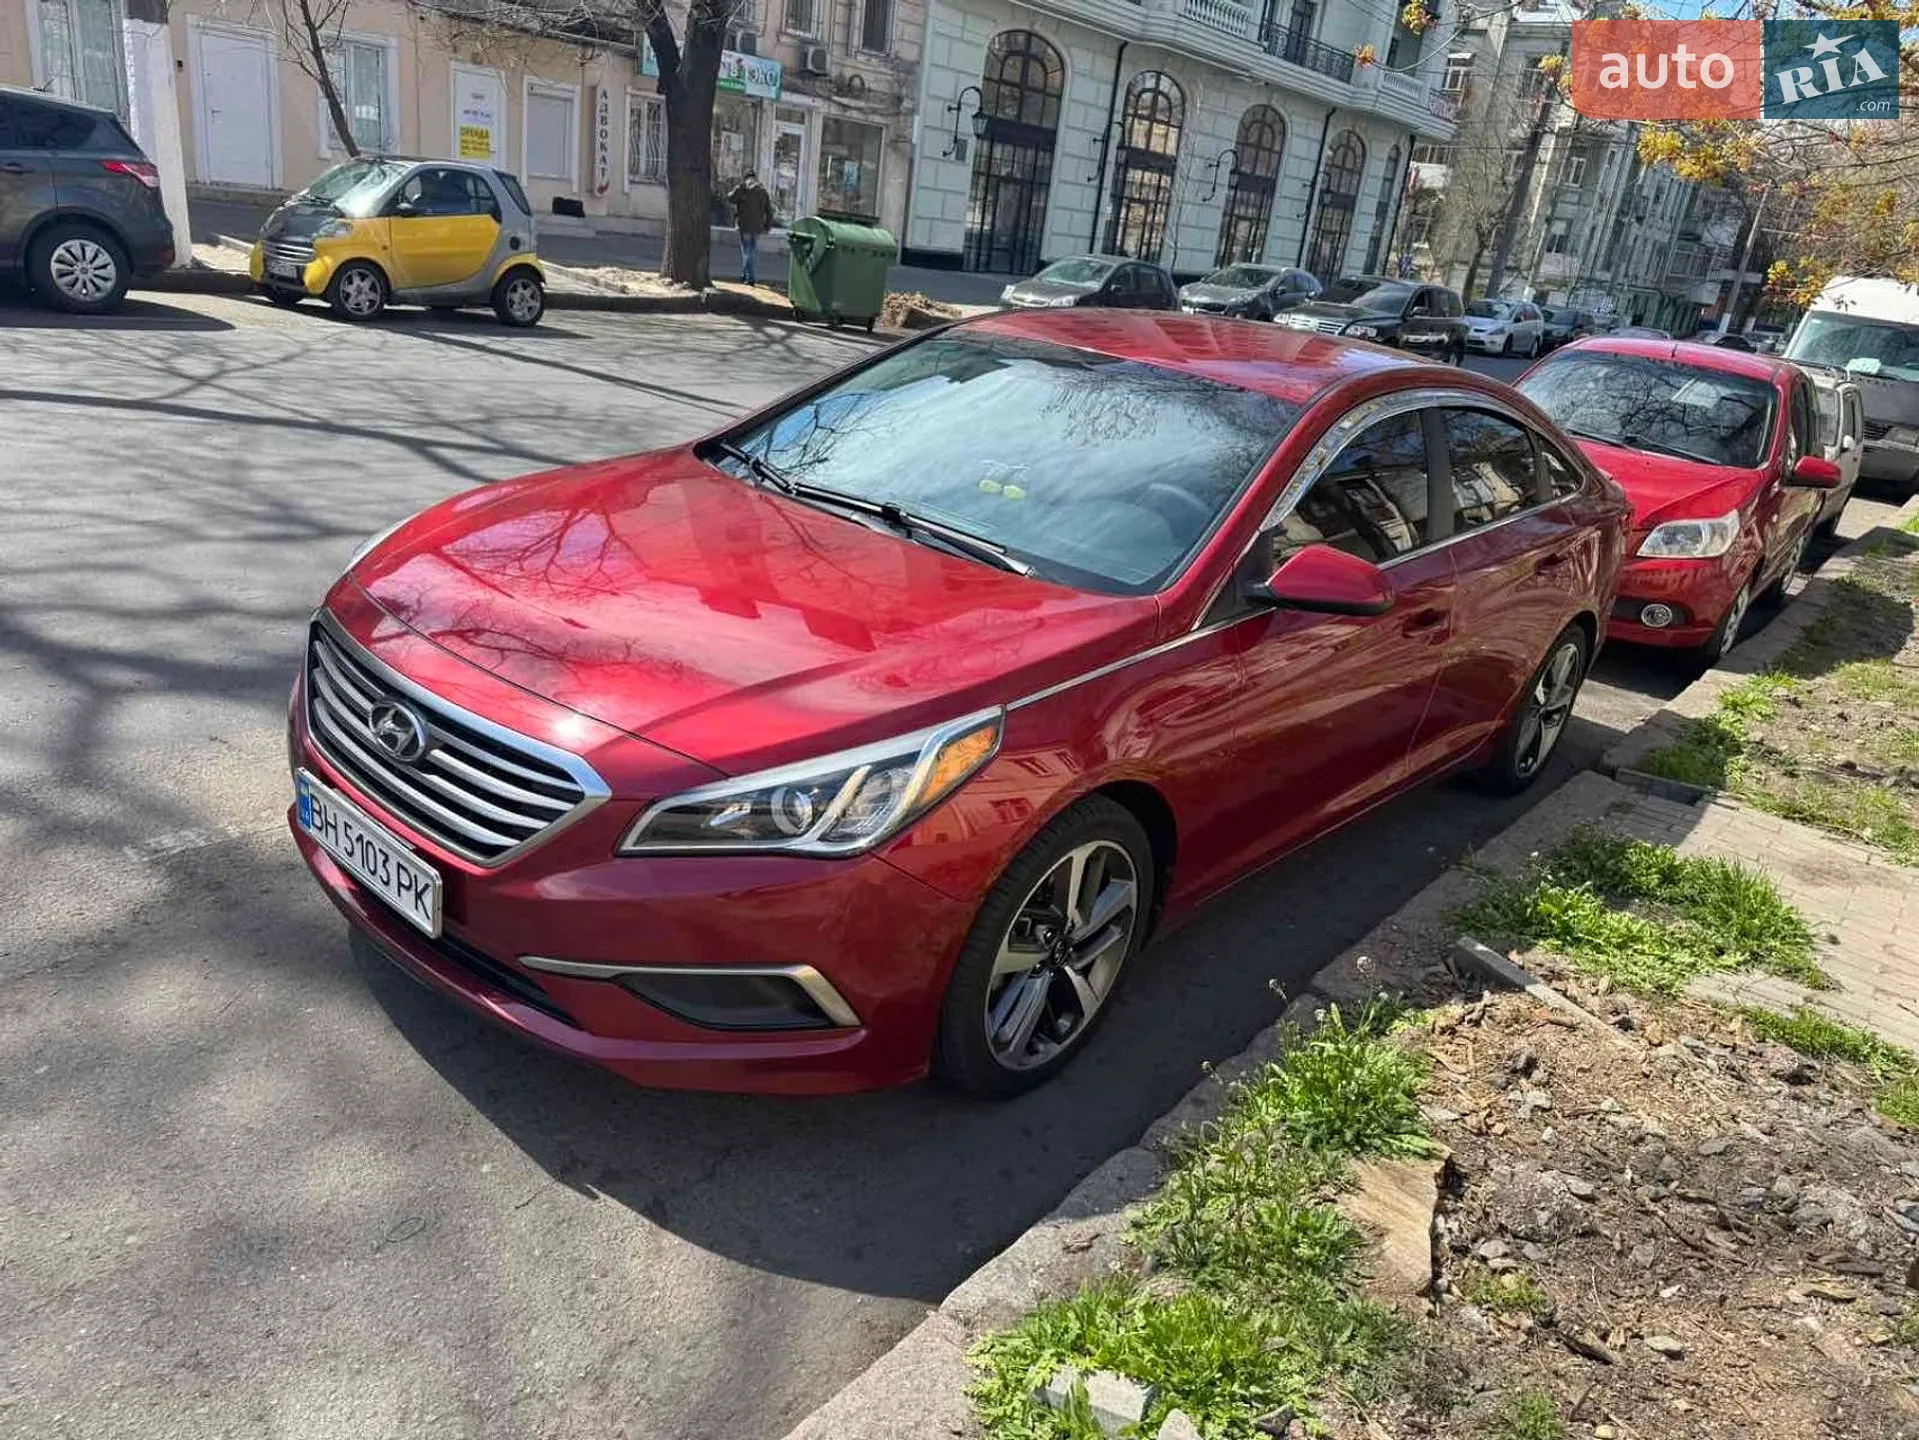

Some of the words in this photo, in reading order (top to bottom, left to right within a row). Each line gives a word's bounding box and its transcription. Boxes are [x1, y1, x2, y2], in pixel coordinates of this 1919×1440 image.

[600, 88, 609, 179] АДВОКАТ
[311, 793, 339, 847] BH
[343, 821, 391, 887] 5103
[396, 861, 432, 921] PK
